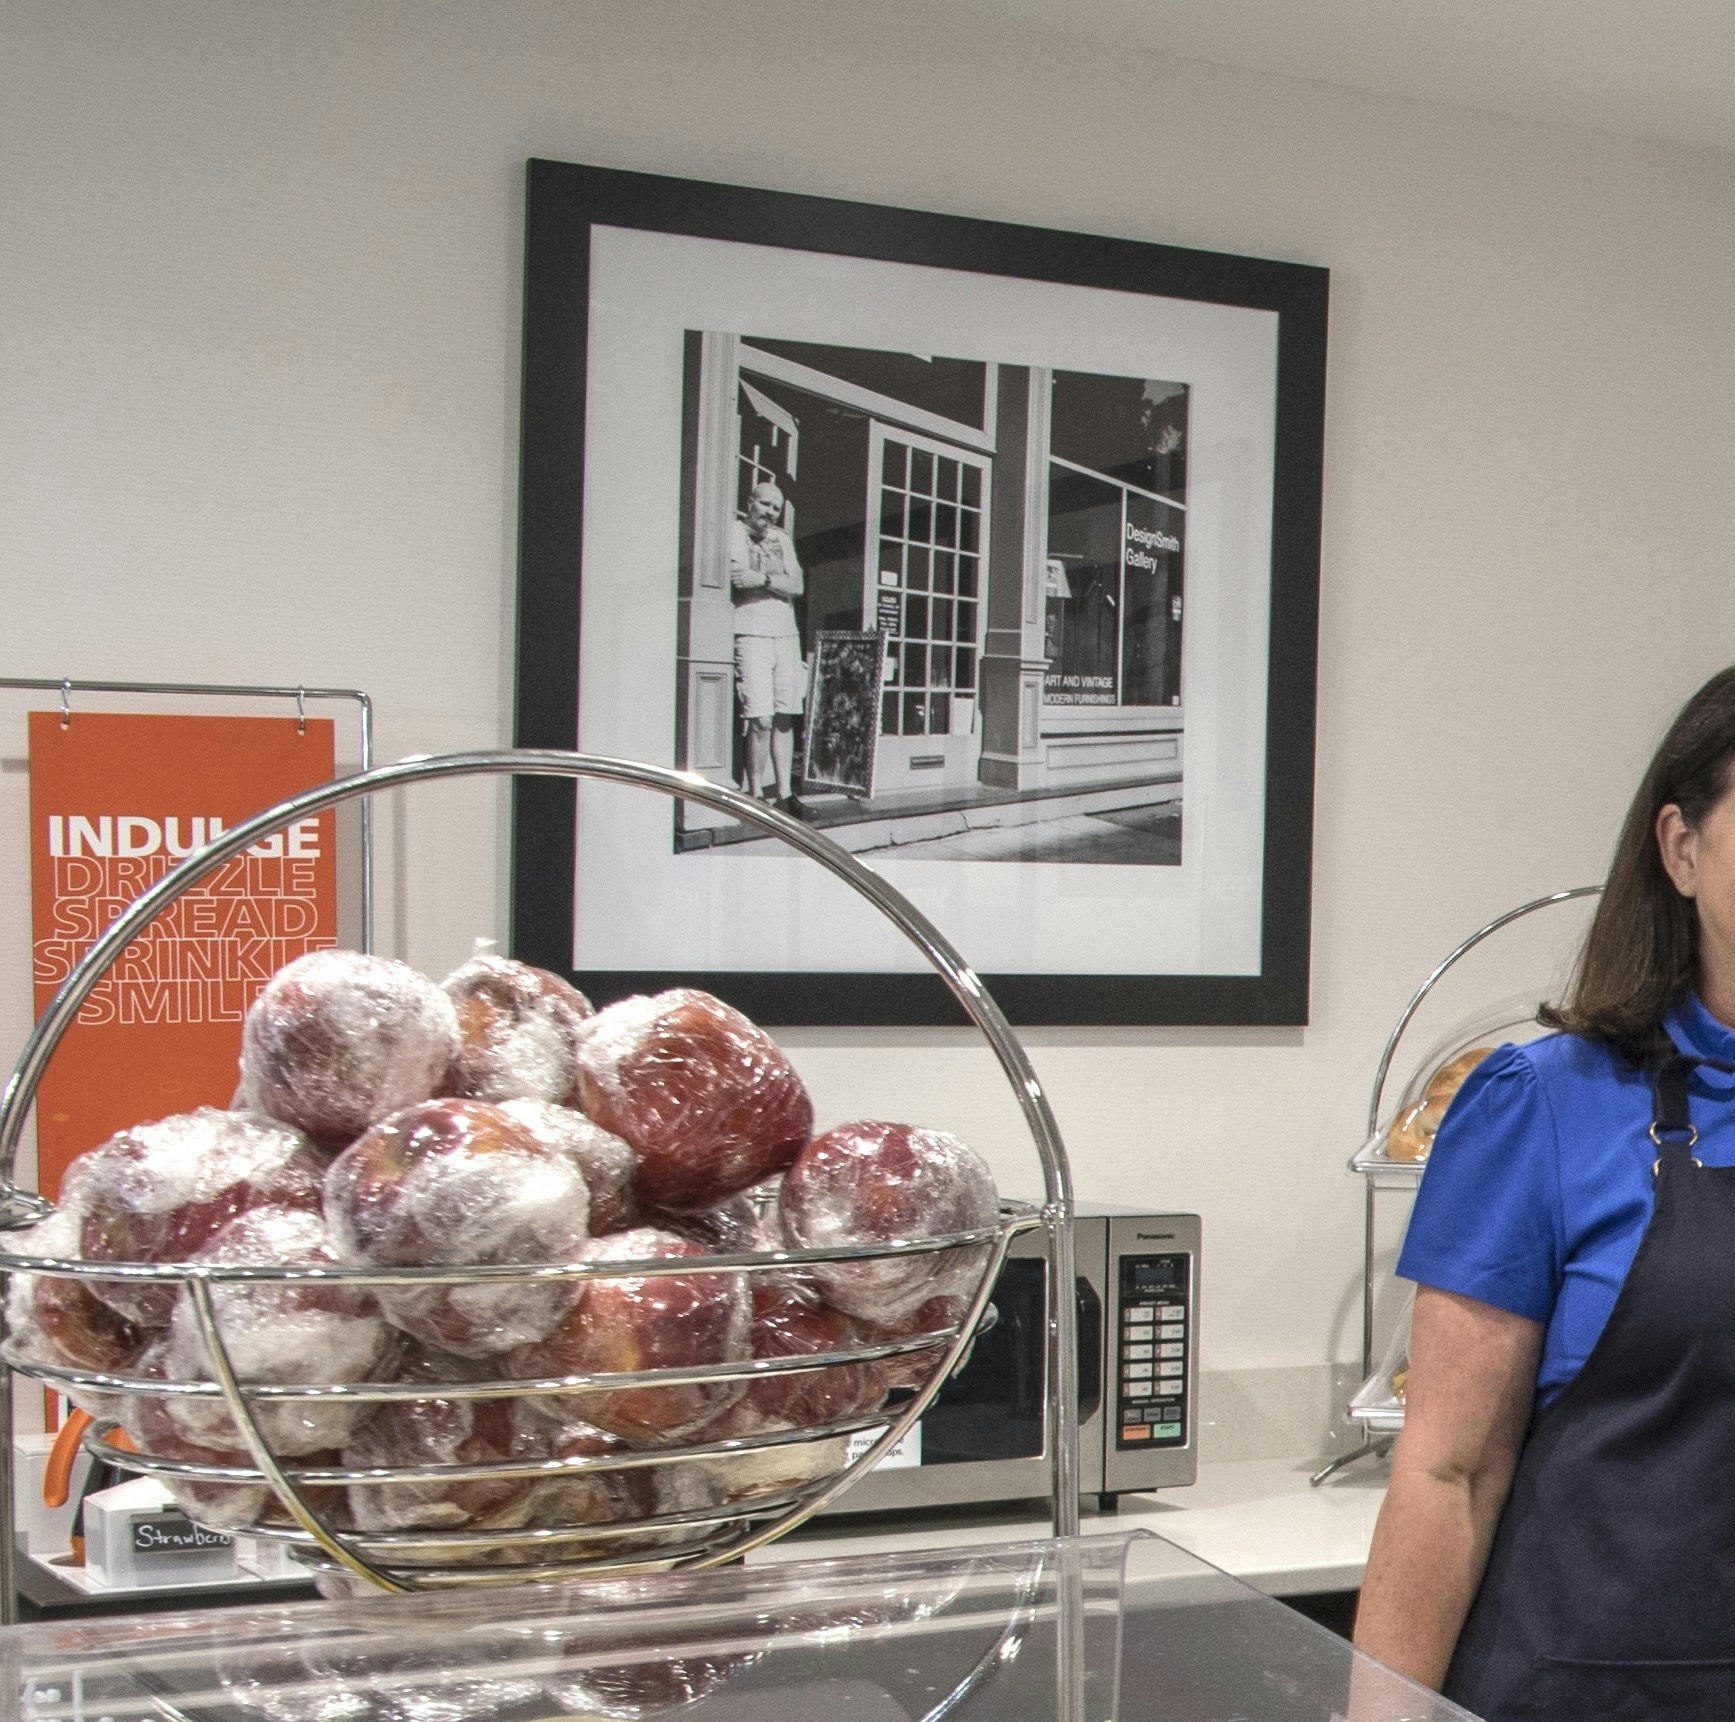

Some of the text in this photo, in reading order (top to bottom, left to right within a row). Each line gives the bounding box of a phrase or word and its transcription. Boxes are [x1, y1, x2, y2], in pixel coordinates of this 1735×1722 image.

[1126, 522, 1180, 553] DesignSmith
[1126, 547, 1158, 575] Gallery
[1045, 674, 1114, 689] ART AND VINTAGE
[1043, 693, 1116, 705] MODERN FURNISHINGS
